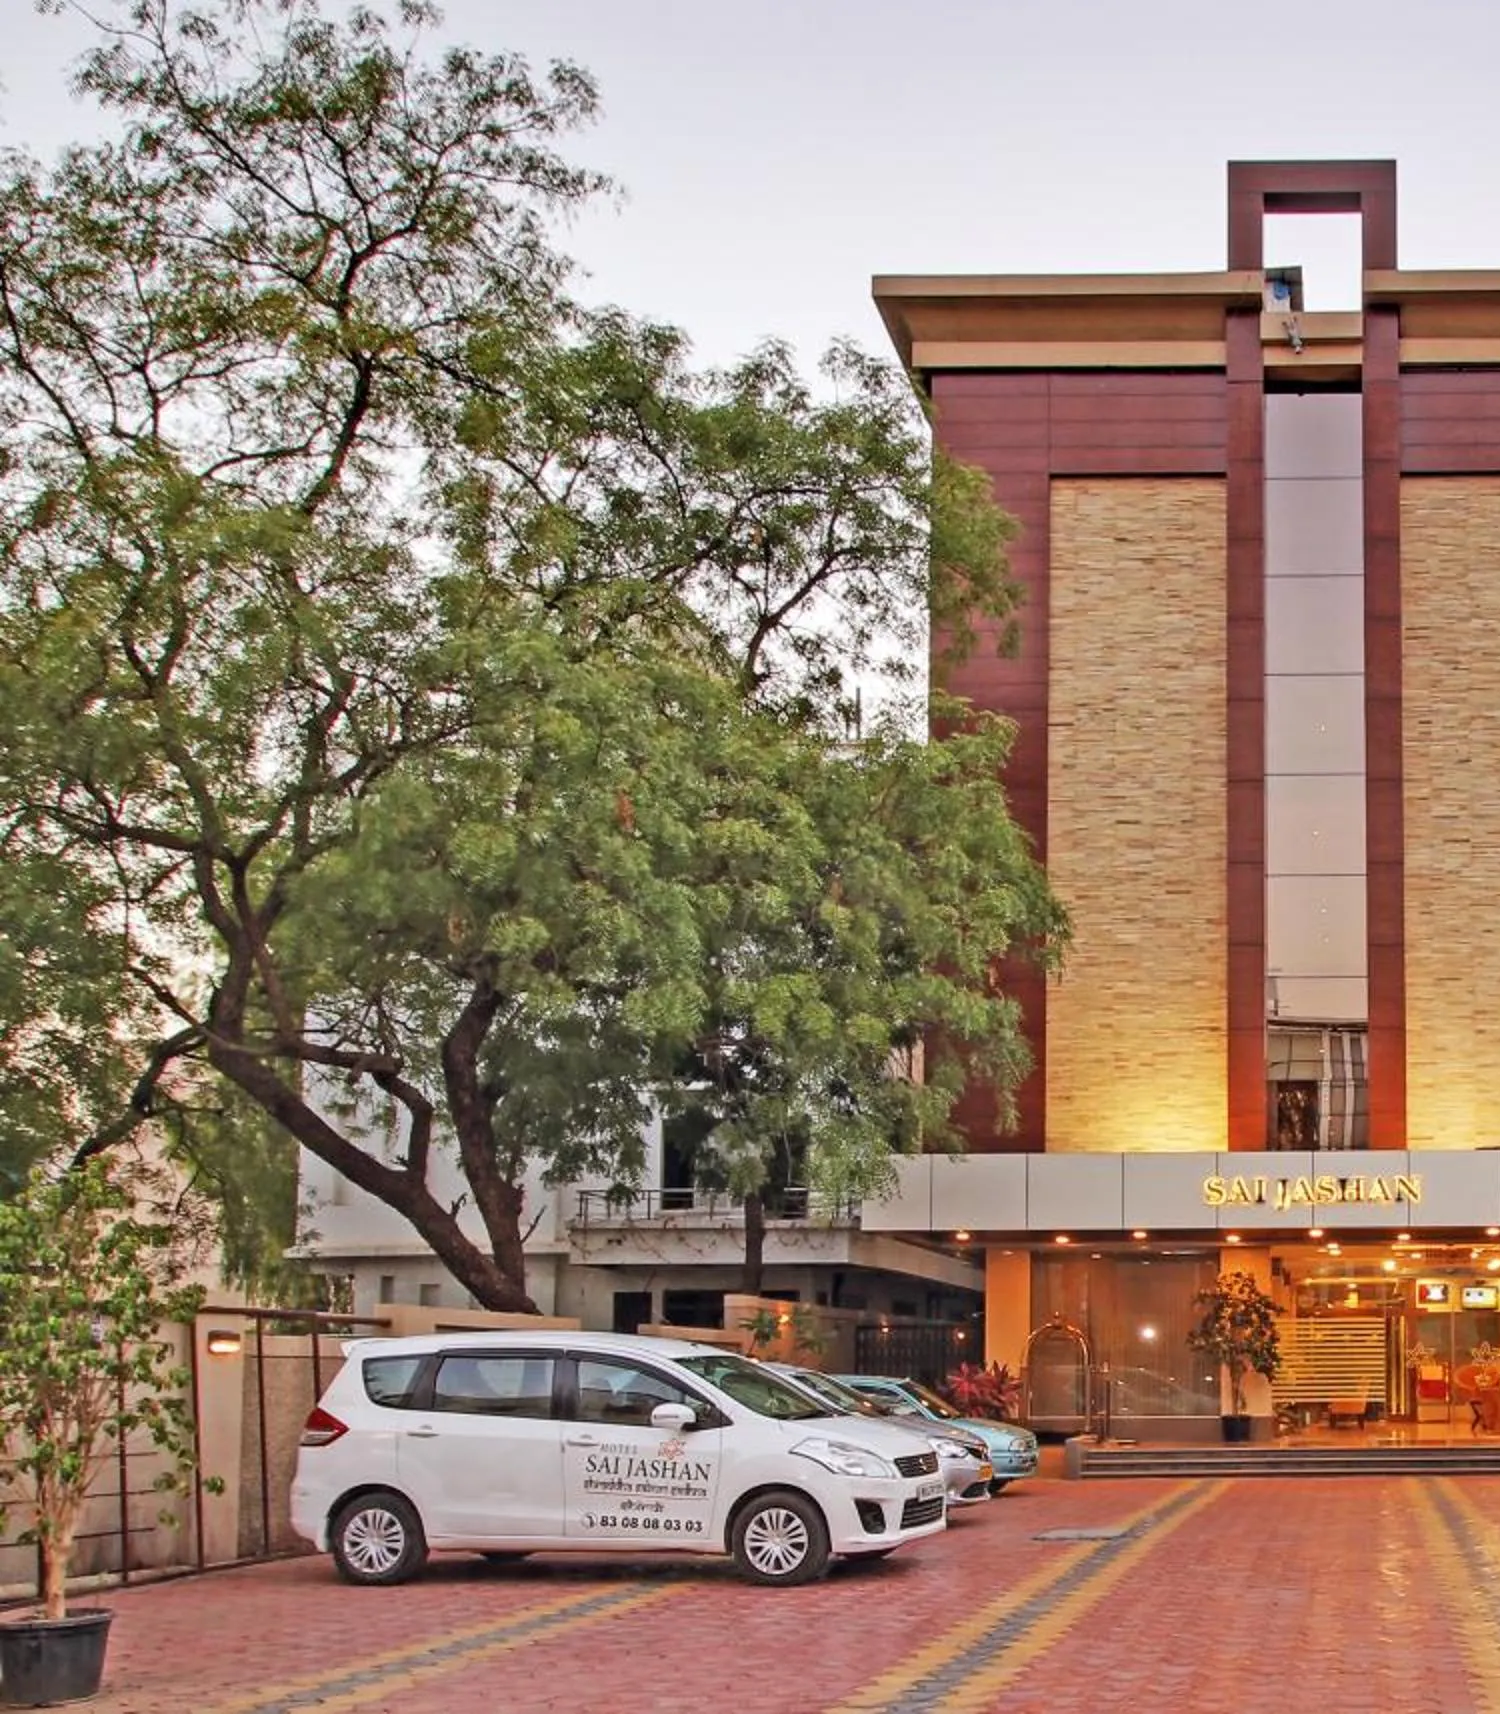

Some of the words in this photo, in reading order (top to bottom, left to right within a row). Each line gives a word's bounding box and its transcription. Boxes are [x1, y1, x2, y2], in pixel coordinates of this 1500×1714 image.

[1204, 1175, 1267, 1204] SAI
[1275, 1174, 1422, 1211] JASHAN
[586, 1454, 620, 1474] SAI
[626, 1458, 711, 1481] JASHAN
[600, 1515, 617, 1527] 83
[621, 1516, 639, 1529] 08
[663, 1518, 681, 1531] 03
[685, 1519, 703, 1532] 03
